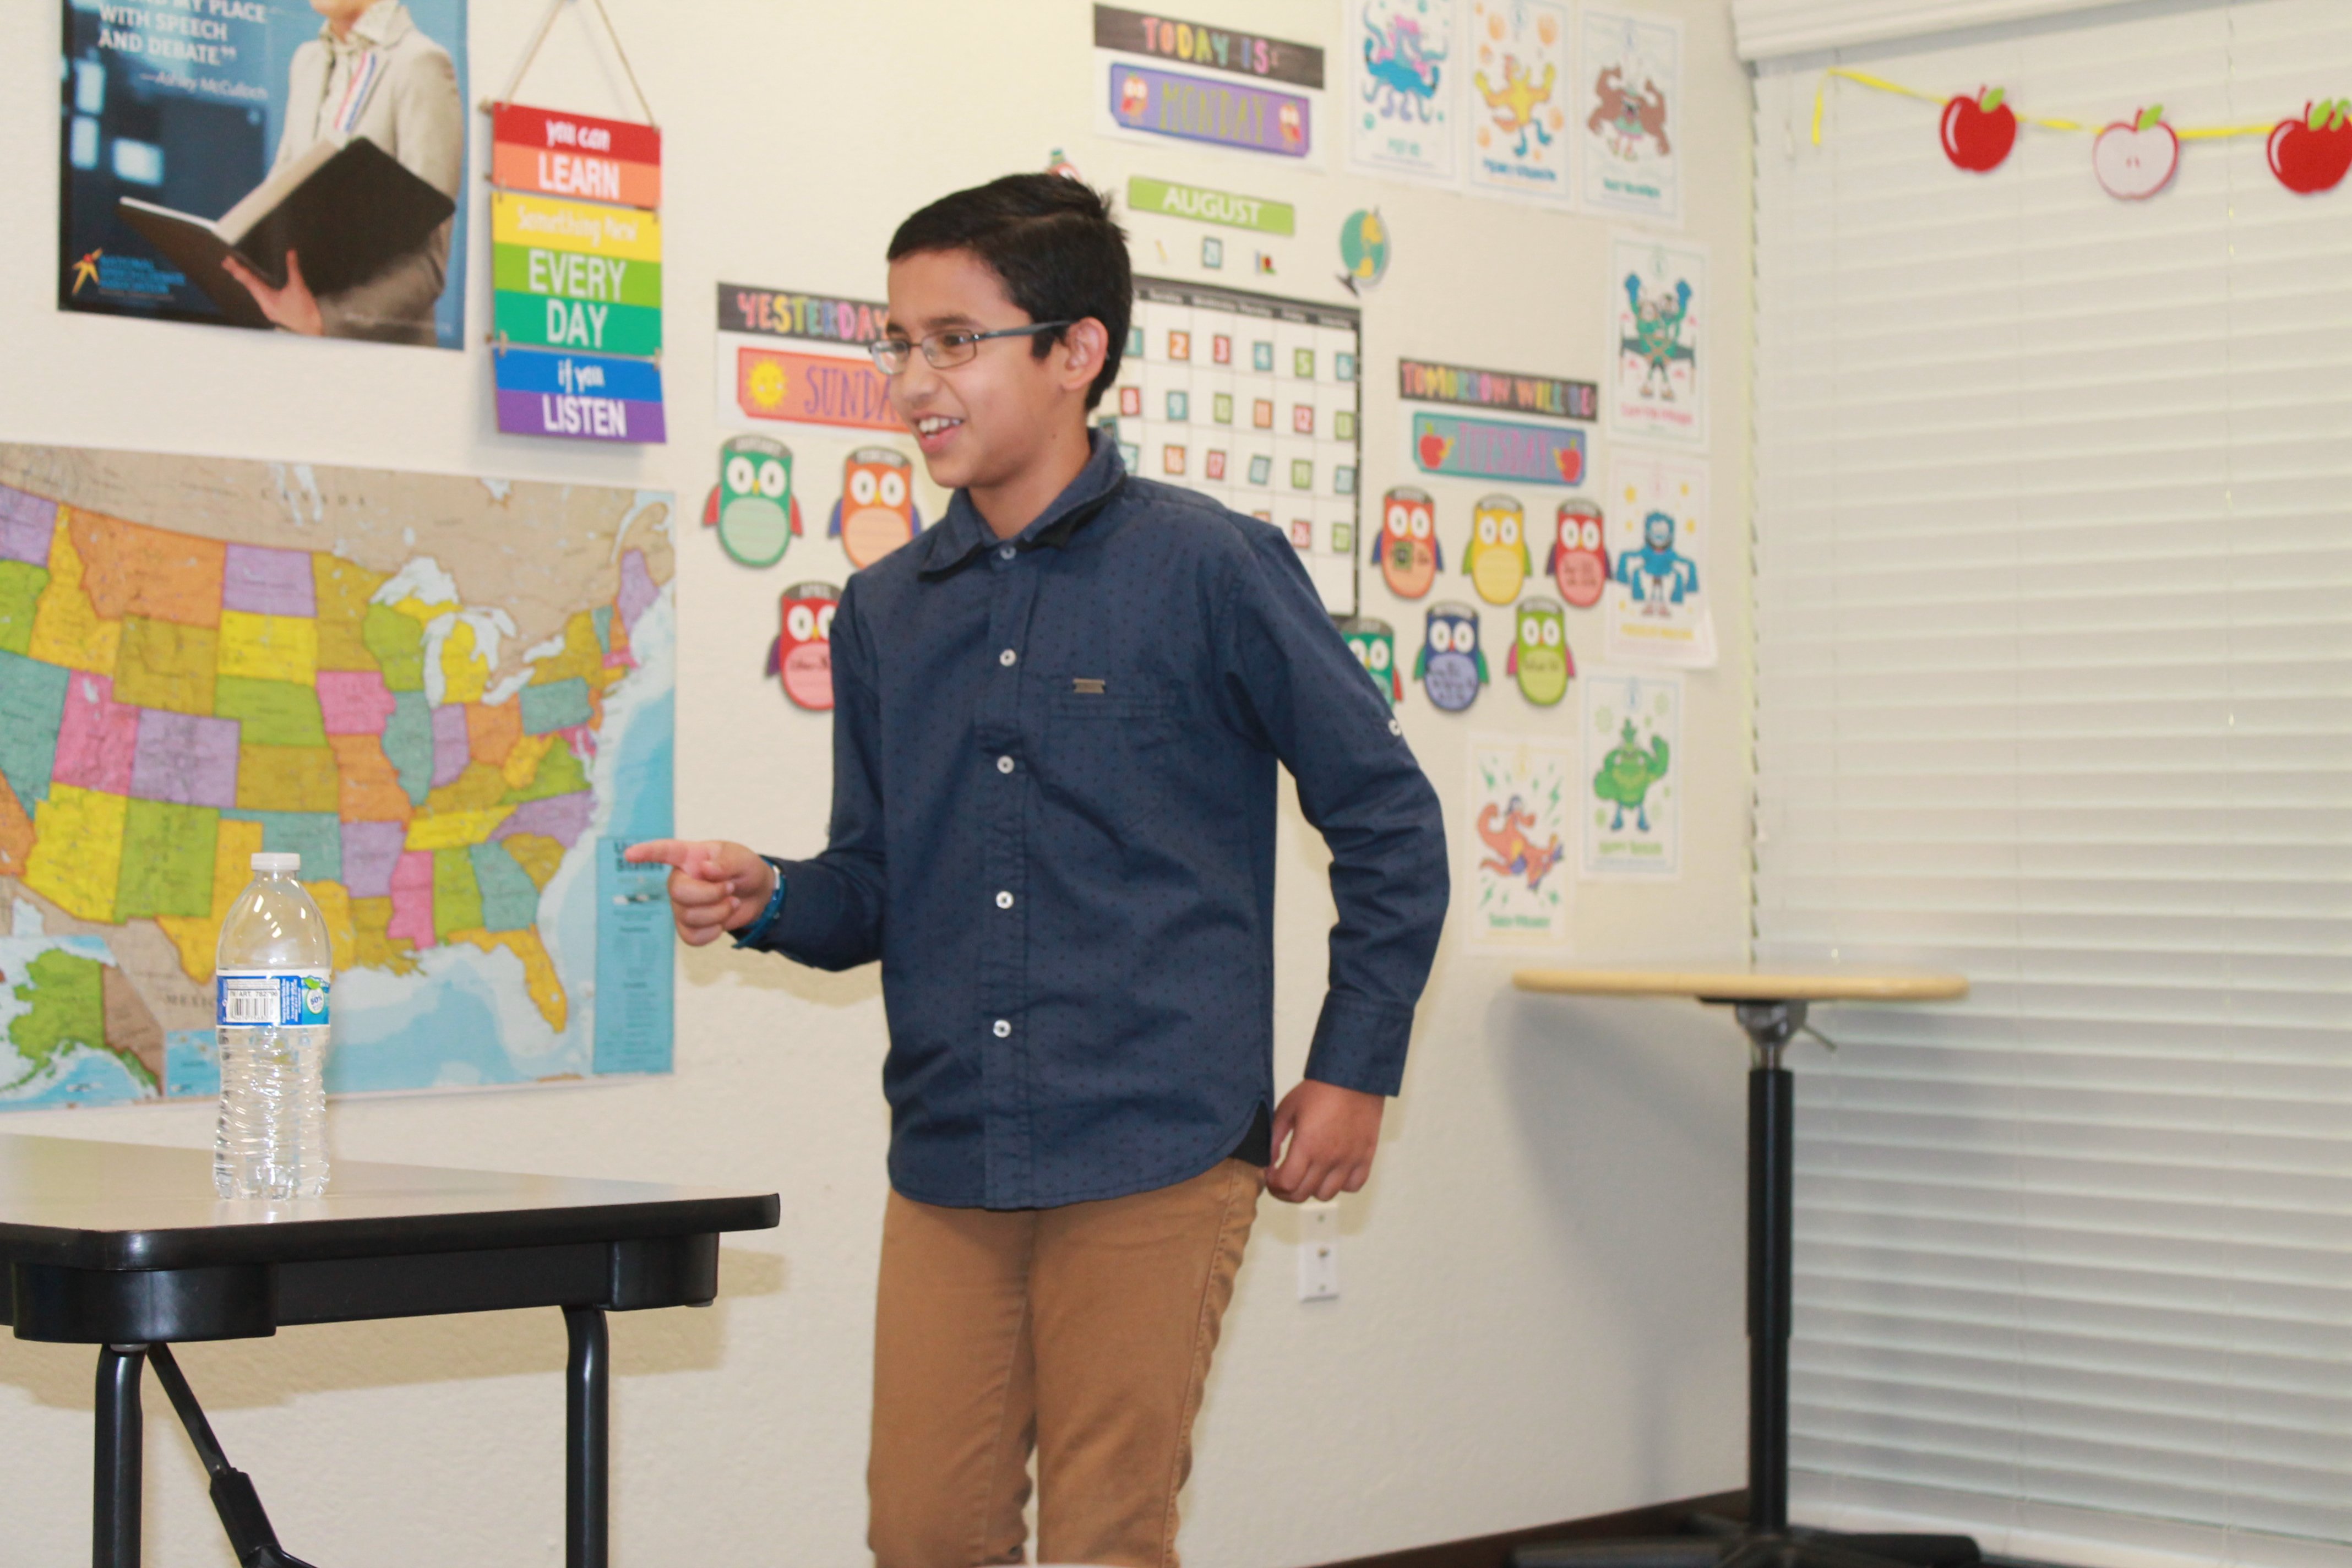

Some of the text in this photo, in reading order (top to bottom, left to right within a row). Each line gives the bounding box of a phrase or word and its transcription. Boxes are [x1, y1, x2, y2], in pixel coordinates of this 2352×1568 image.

[99, 4, 228, 42] WITH SPEECH
[209, 0, 266, 23] PLACE
[97, 29, 143, 53] AND
[1142, 16, 1229, 67] TODAY
[1158, 80, 1265, 144] MONDAY
[545, 118, 611, 153] you can
[538, 151, 621, 200] LEARN
[516, 204, 639, 247] Something New
[1162, 186, 1265, 226] AUGUST
[528, 248, 628, 303] EVERY
[546, 297, 609, 349] DAY
[737, 291, 889, 344] YESTERDAY
[558, 358, 605, 394] if you
[1170, 333, 1188, 360] 2
[1215, 336, 1228, 362] 3
[1257, 344, 1270, 368] 4
[1295, 351, 1311, 376] 5
[804, 363, 897, 422] SUNDA
[1169, 393, 1184, 419] 9
[542, 394, 628, 438] LISTEN
